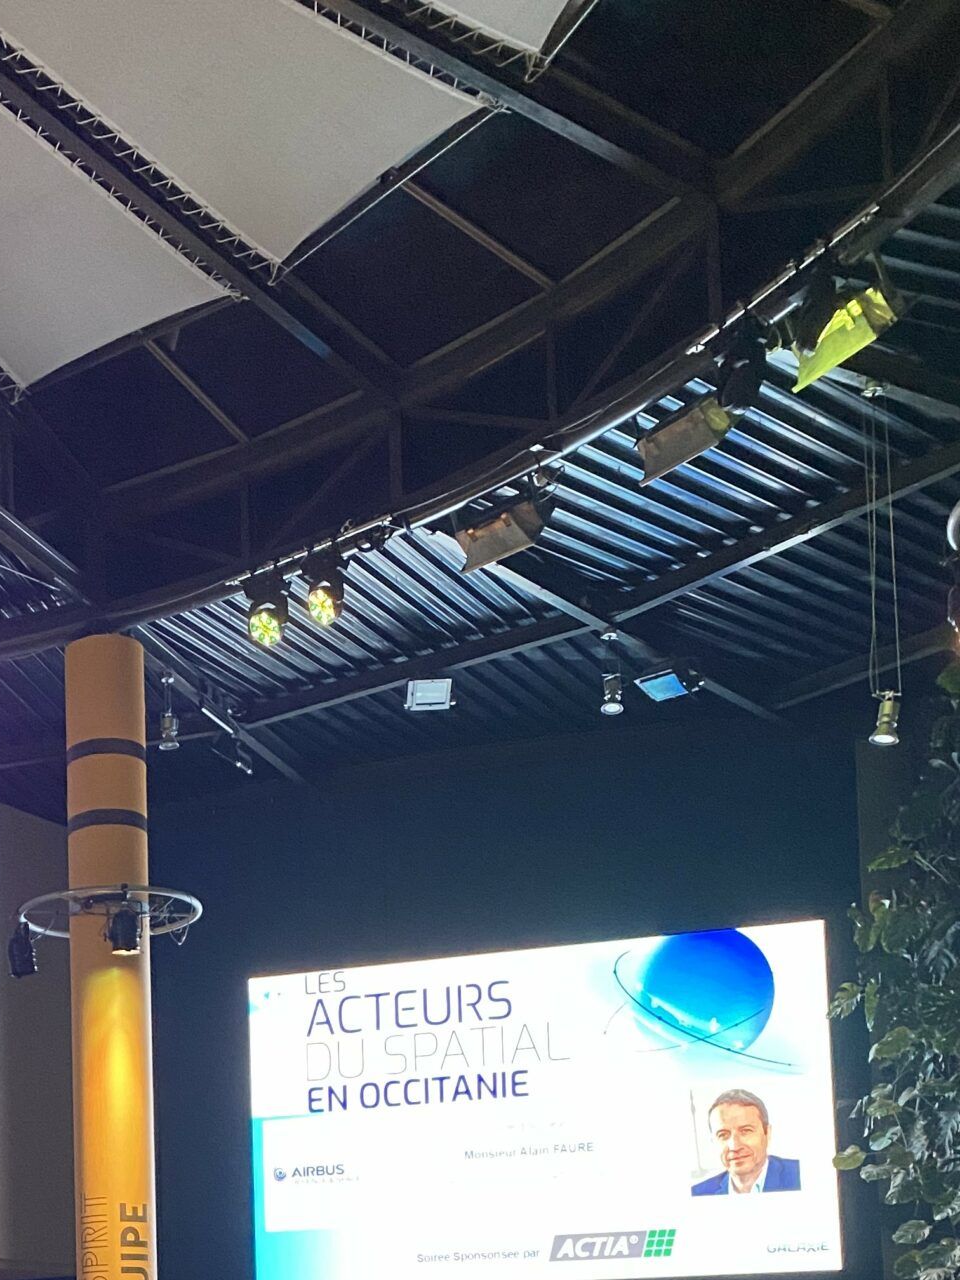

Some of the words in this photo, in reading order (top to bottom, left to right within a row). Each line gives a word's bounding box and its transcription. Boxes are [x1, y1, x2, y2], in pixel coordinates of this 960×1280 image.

[304, 971, 346, 995] LES
[306, 980, 512, 1037] ACTEURS
[306, 1038, 365, 1082] DU
[384, 1022, 571, 1075] SPATIAL
[307, 1085, 347, 1113] EN
[359, 1069, 529, 1109] OCCITANIE
[553, 1142, 594, 1154] FAURE
[291, 1164, 345, 1178] AIRBUS
[556, 1235, 630, 1259] ACTIA
